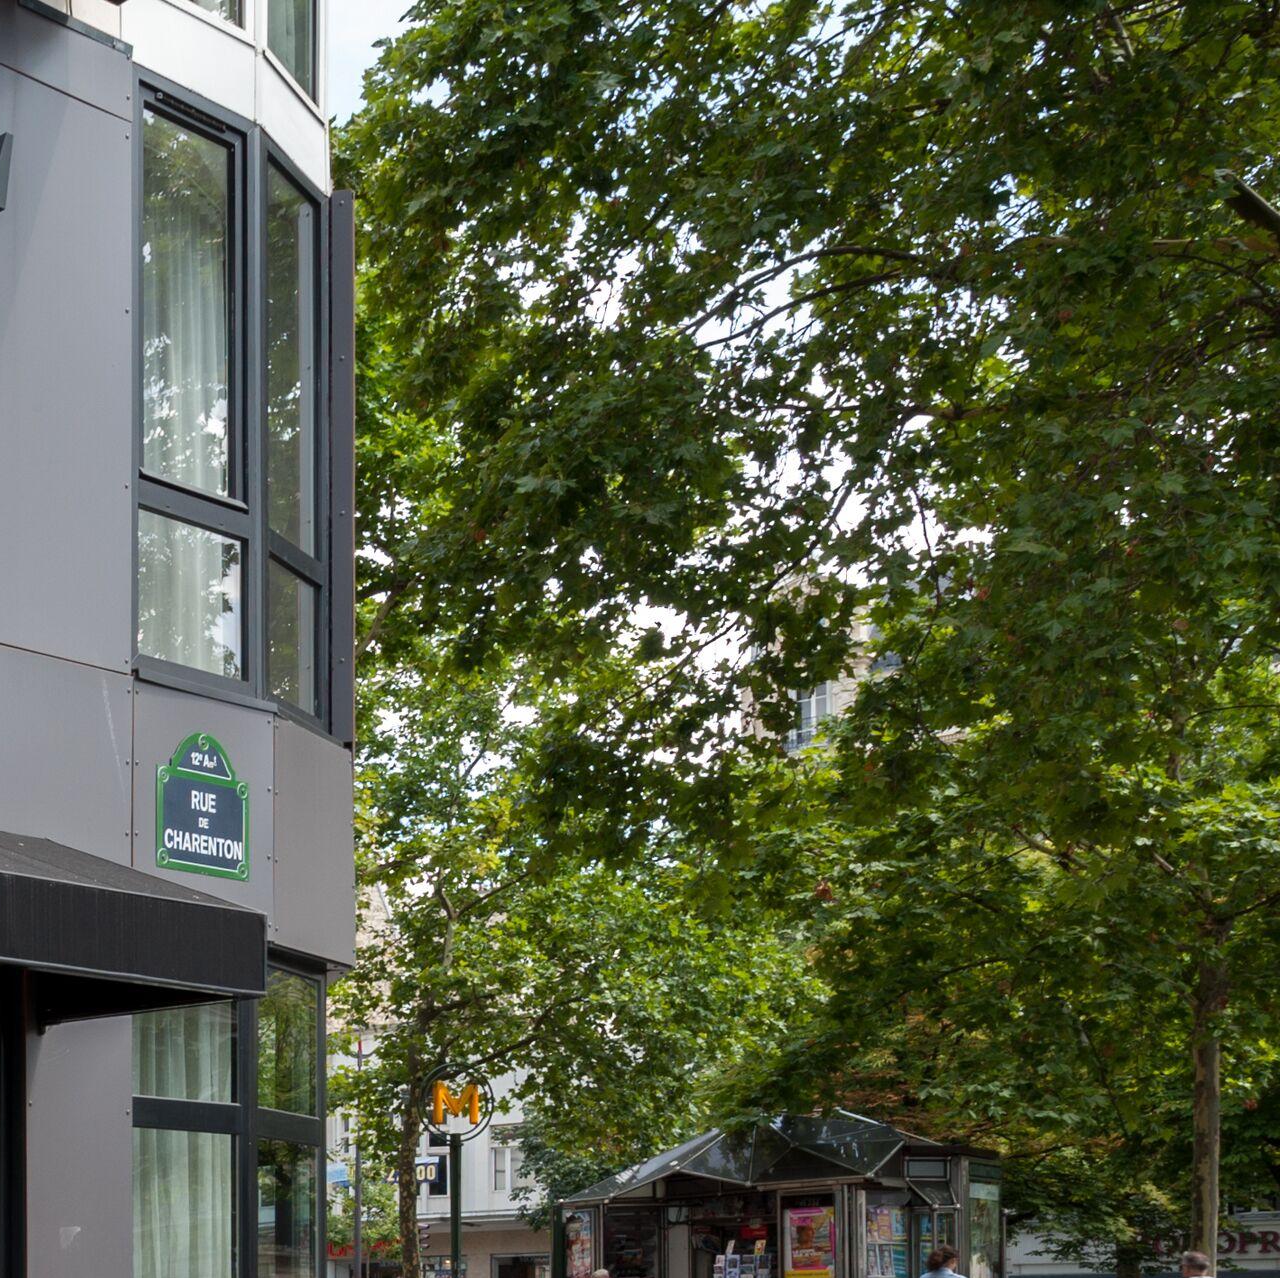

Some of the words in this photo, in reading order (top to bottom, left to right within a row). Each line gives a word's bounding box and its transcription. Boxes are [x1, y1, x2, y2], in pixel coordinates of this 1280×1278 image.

[191, 790, 216, 813] RUE
[198, 817, 209, 829] DE
[164, 828, 242, 860] CHARENTON
[432, 1080, 478, 1124] M
